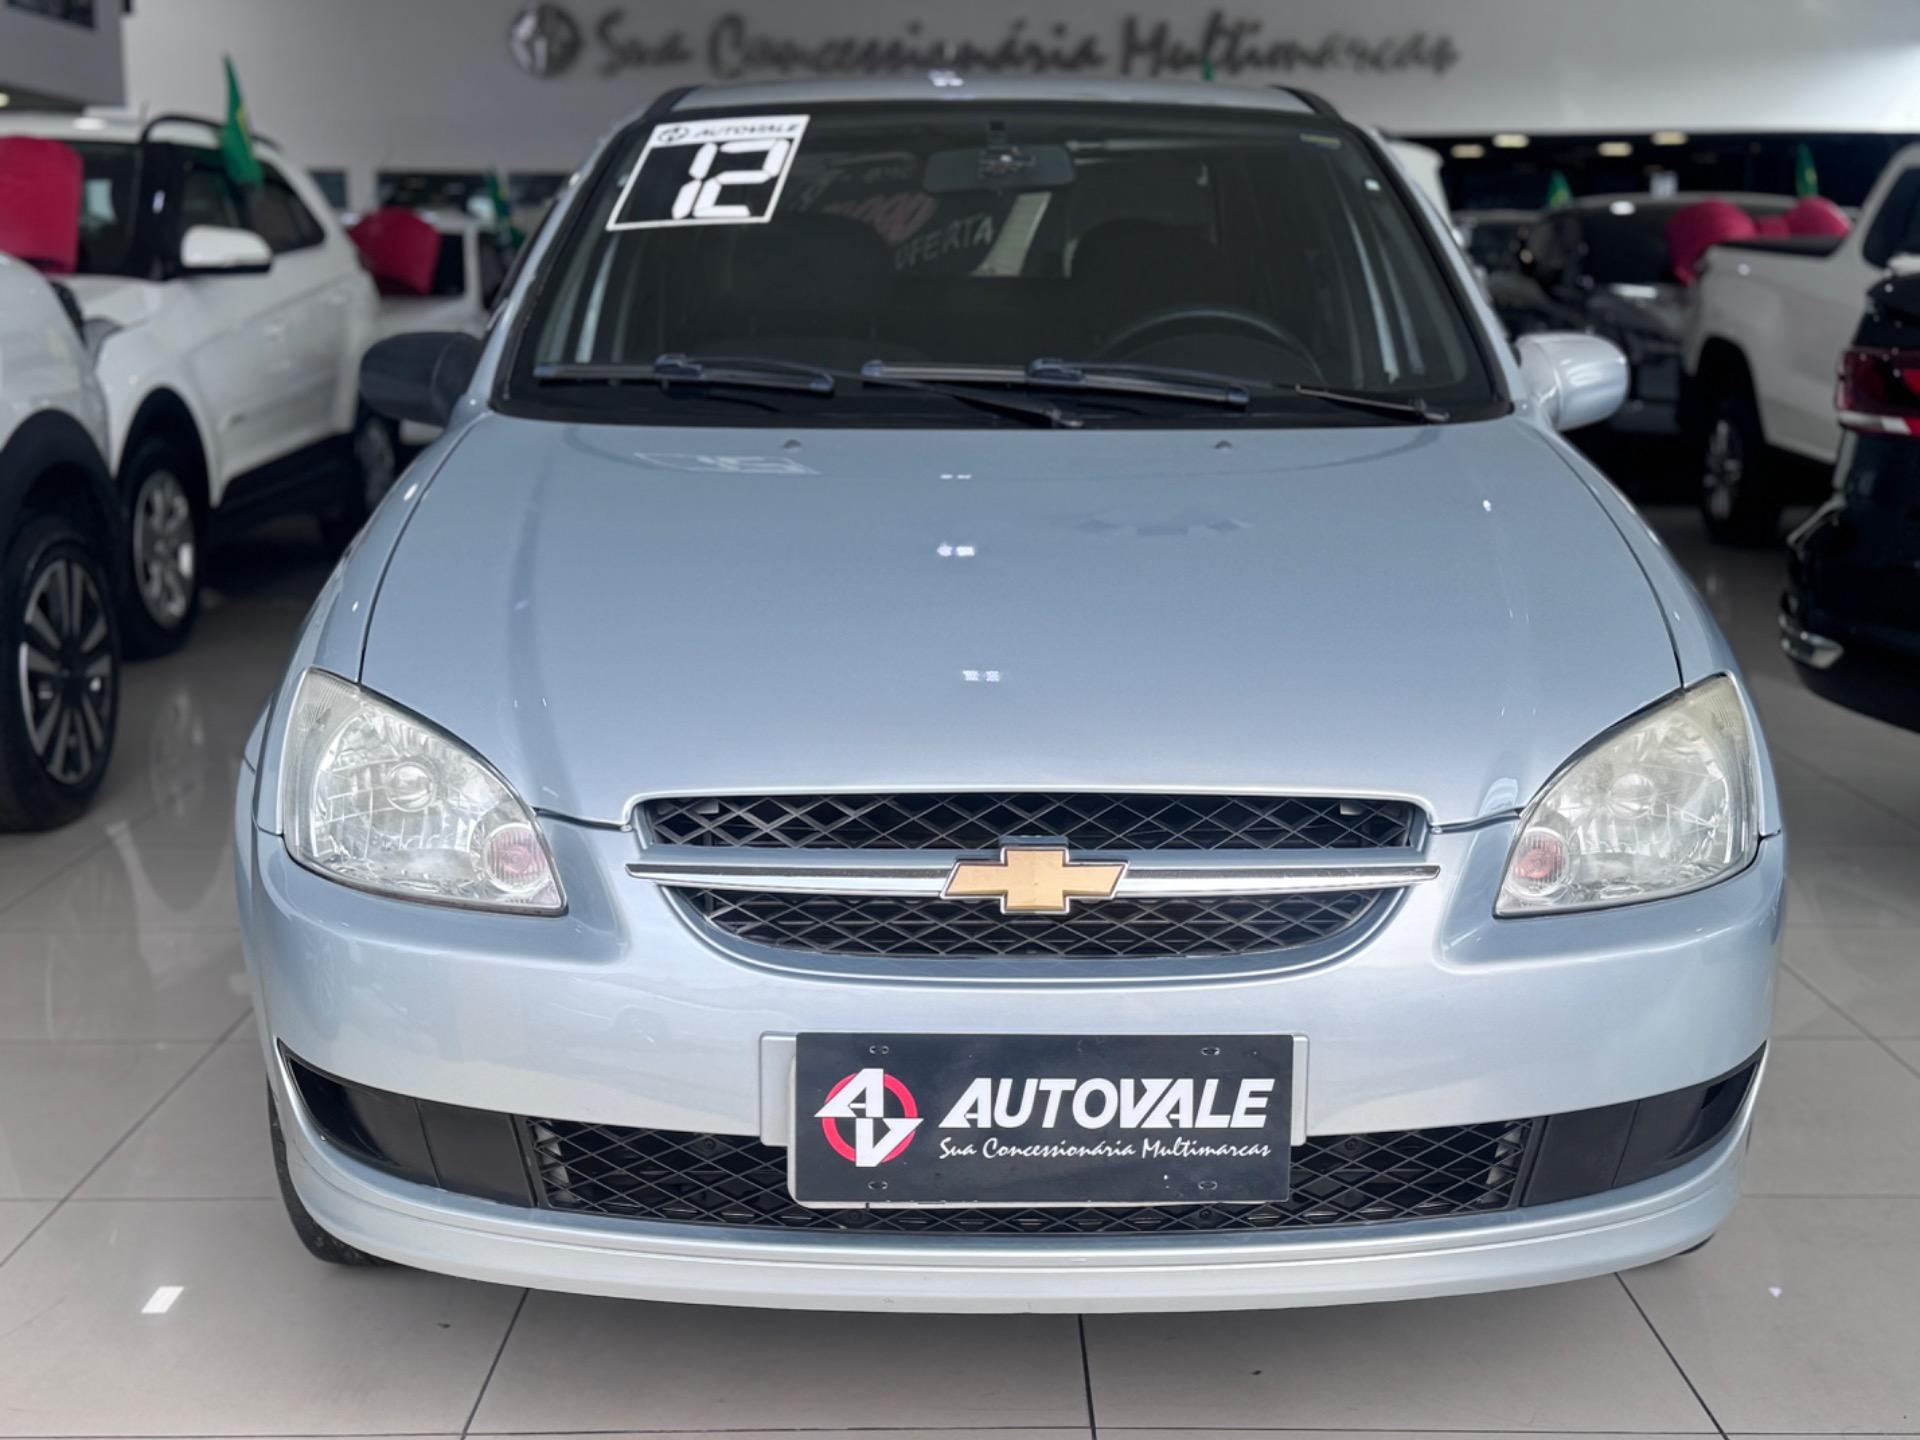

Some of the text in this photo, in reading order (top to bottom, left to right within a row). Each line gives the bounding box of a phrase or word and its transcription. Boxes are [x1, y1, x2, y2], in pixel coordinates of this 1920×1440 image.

[597, 10, 692, 76] Sua
[694, 123, 799, 138] AUTOVALE
[671, 139, 790, 220] 12
[939, 1078, 1274, 1128] AUTOVALE
[939, 1137, 1272, 1160] Sua Concessionária Multimarcas
